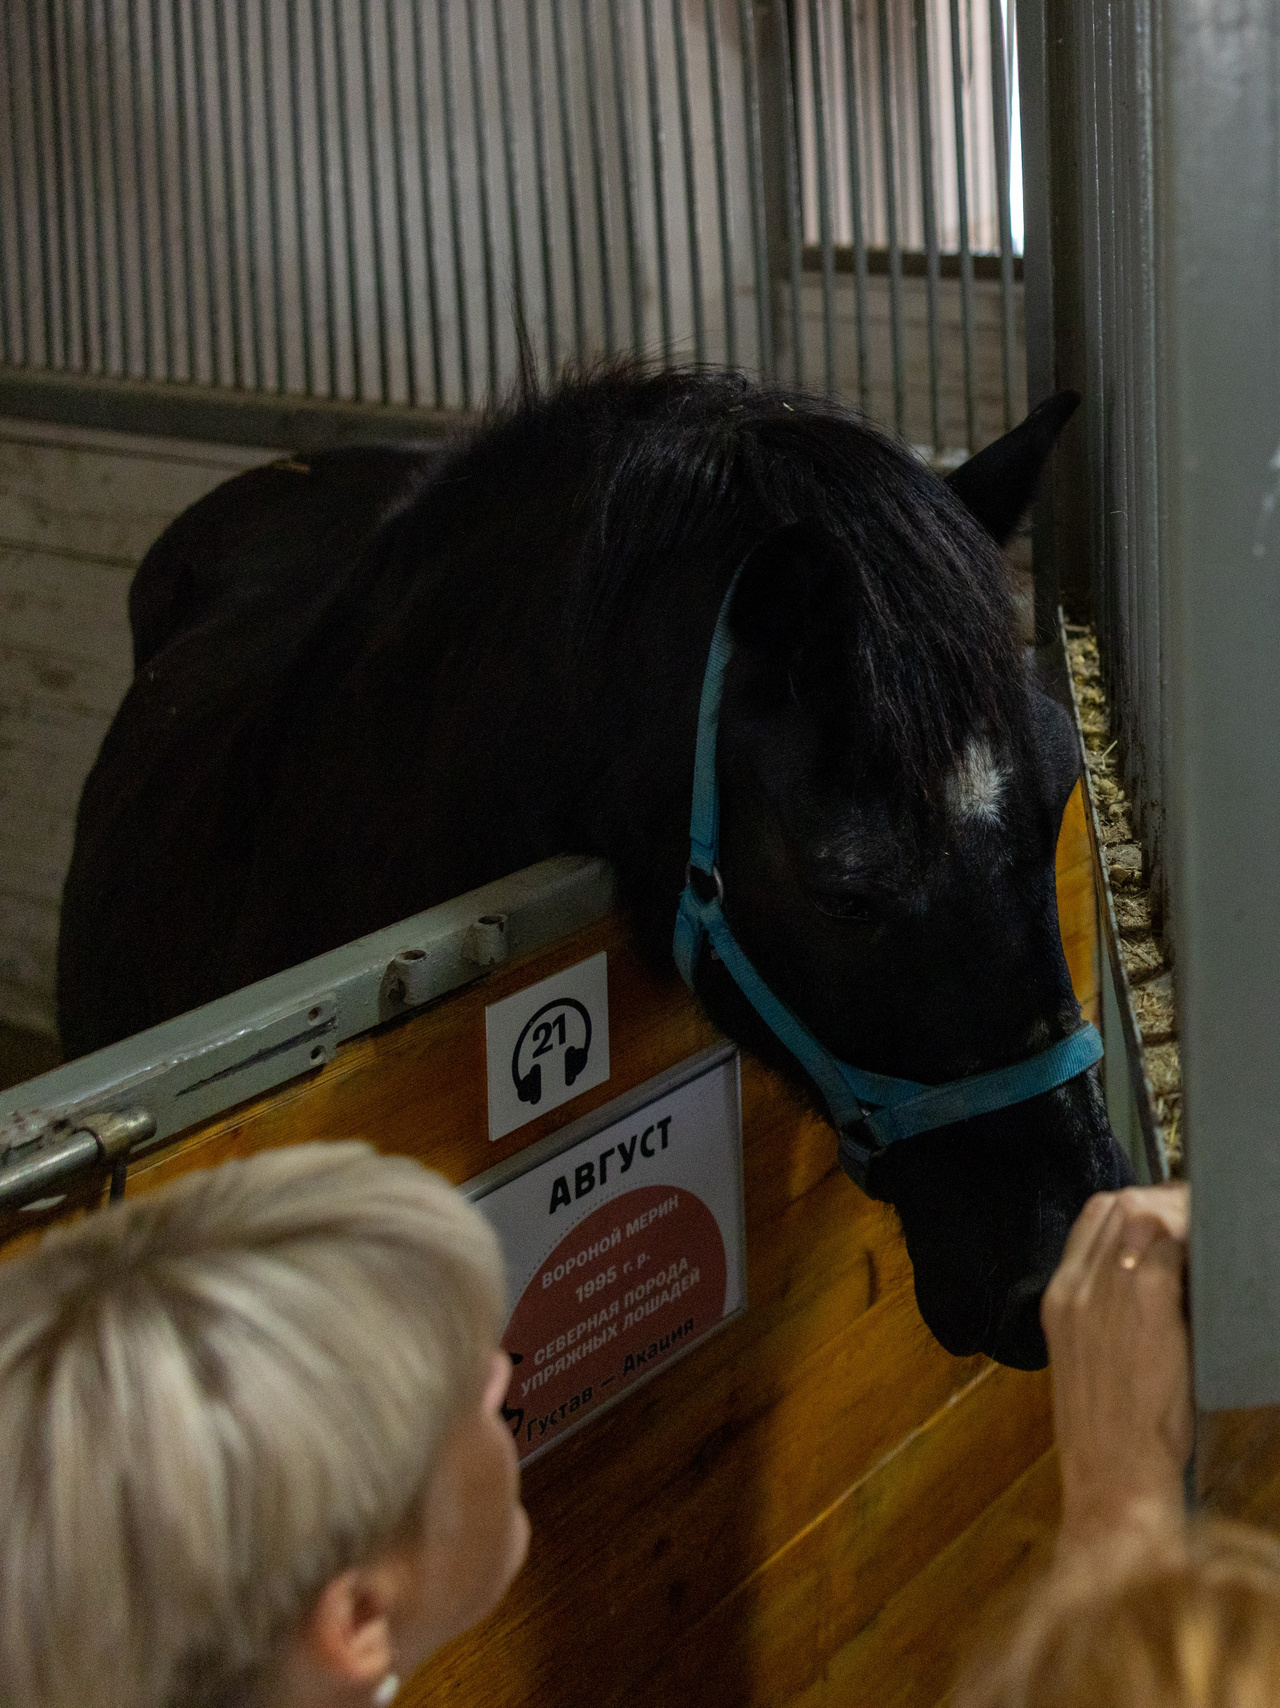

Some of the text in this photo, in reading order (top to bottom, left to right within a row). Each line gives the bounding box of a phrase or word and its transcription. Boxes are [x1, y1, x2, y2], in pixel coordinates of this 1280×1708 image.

[533, 1013, 566, 1059] 21
[549, 1115, 672, 1215] АВГУСТ
[541, 1194, 679, 1289] ВОРОНОЙ МЕРИН
[575, 1265, 618, 1303] 1995
[520, 1267, 701, 1397] УПРЯЖНЫХ ЛОШАДЕЙ
[534, 1257, 689, 1366] СЕВЕРНАЯ ПОРОДА
[527, 1386, 593, 1442] Густав
[623, 1317, 695, 1376] Акация
